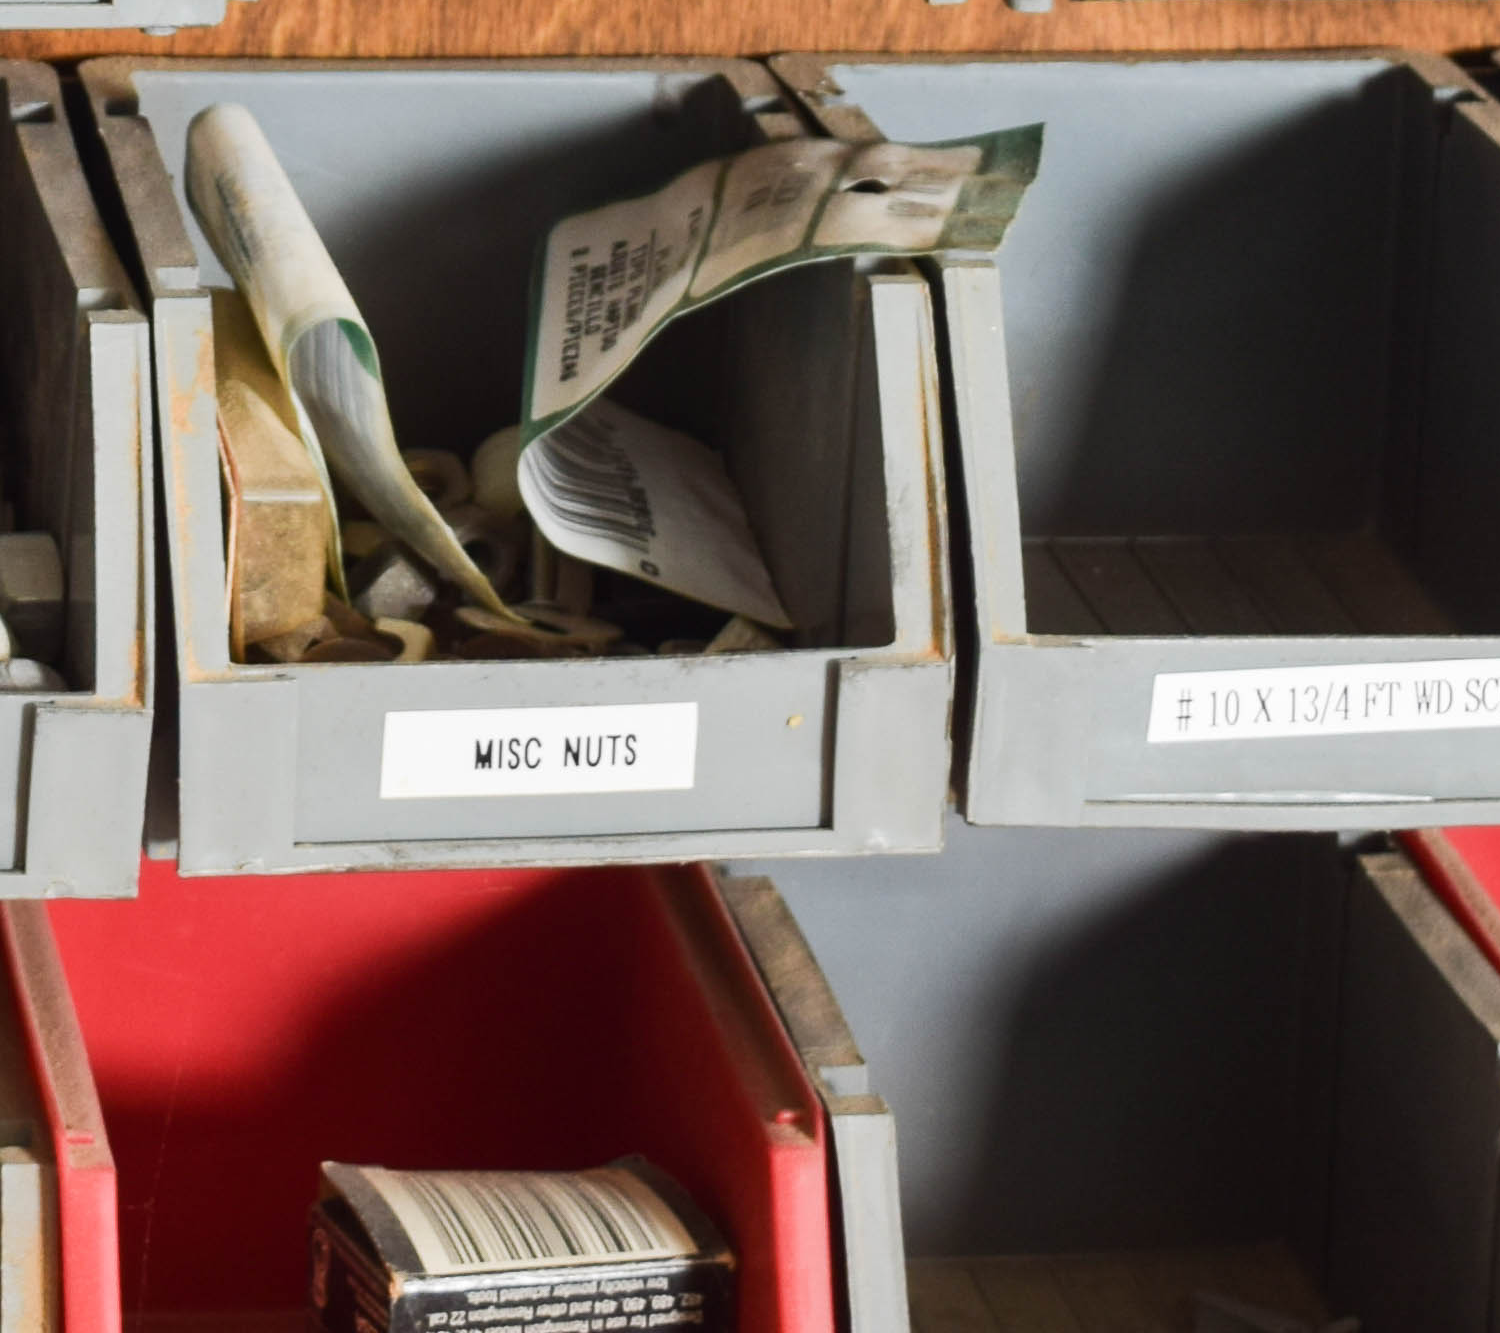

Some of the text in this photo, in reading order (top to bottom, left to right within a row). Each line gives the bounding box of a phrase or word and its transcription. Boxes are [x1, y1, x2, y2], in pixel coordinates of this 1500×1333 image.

[1175, 688, 1194, 731] #
[1210, 688, 1241, 728] 10
[1254, 688, 1272, 723] X
[1363, 681, 1402, 718] FT
[1414, 679, 1454, 715] WD
[474, 733, 637, 771] MISC NUTS
